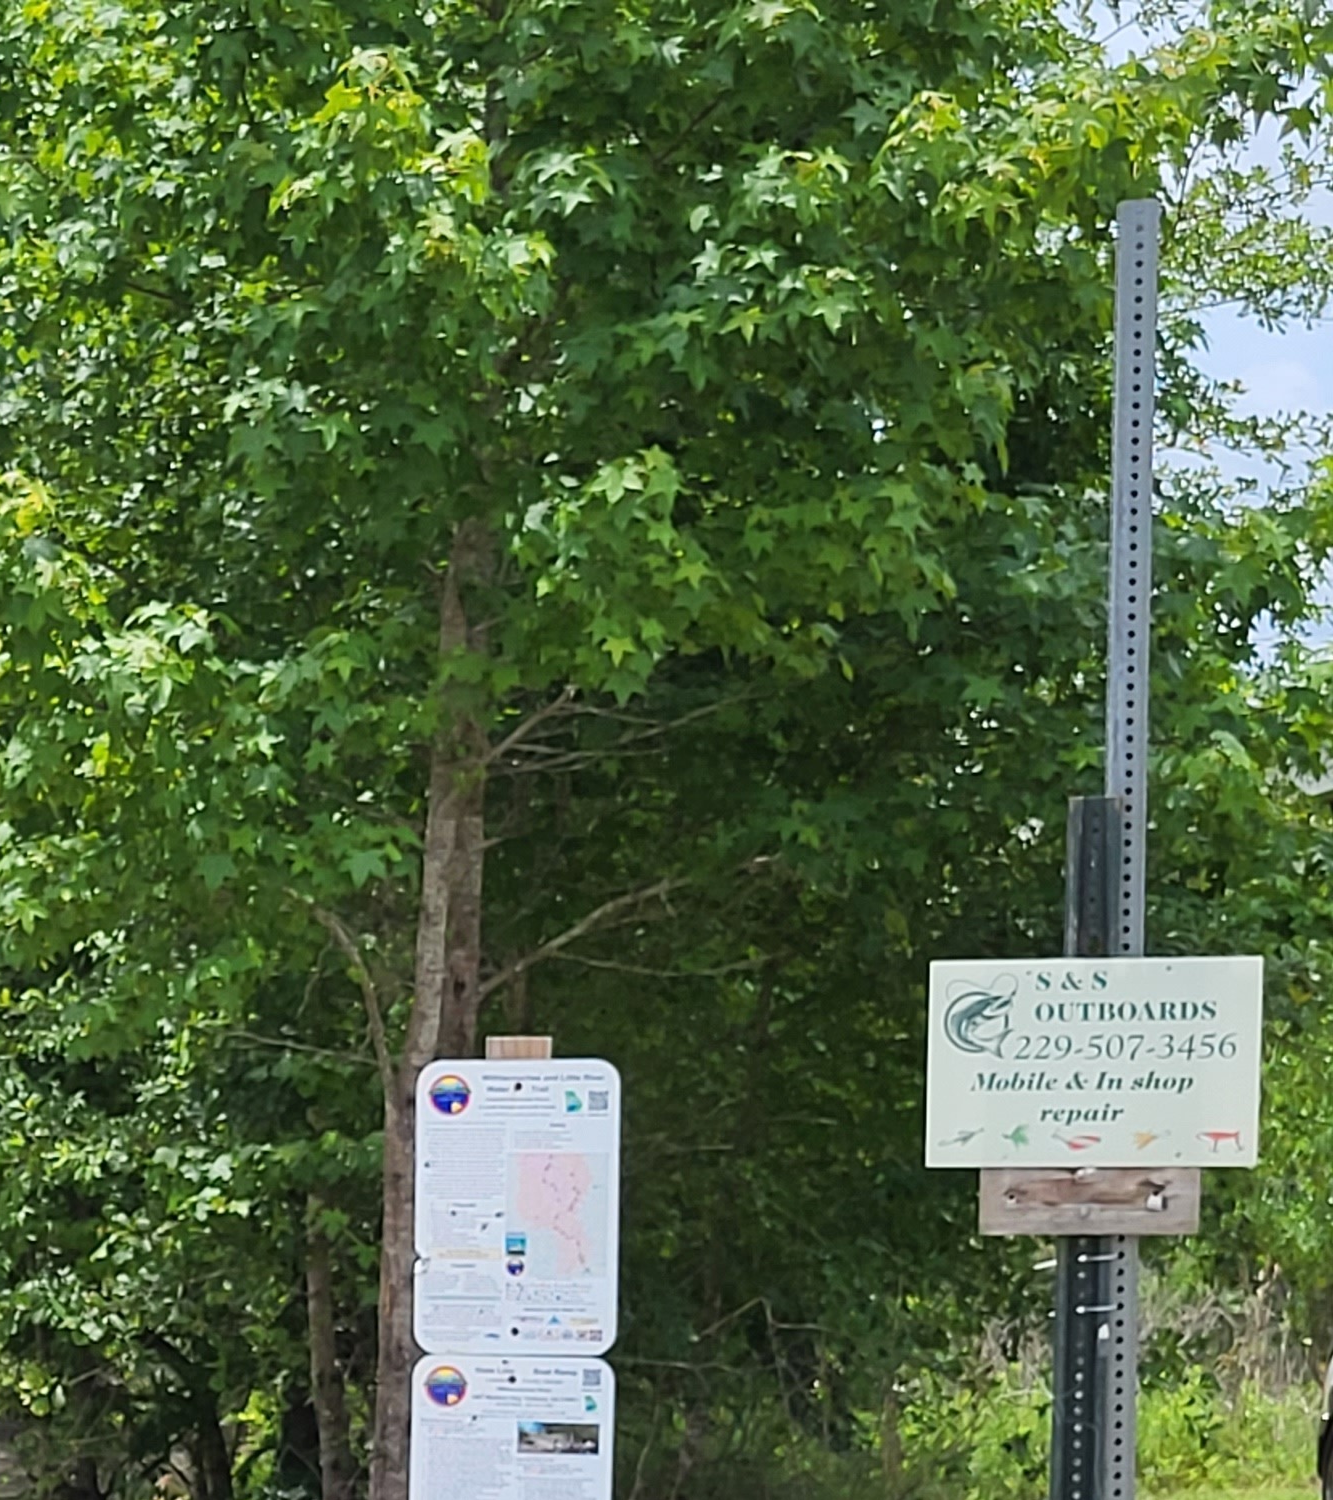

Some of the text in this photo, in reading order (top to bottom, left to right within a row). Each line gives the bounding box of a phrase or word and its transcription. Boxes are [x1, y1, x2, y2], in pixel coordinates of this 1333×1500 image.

[1035, 970, 1109, 991] S & S
[1035, 1000, 1217, 1022] OUTBOARDS
[1013, 1033, 1238, 1061] 229-507-3456
[970, 1070, 1194, 1094] Mobile & In shop
[1039, 1103, 1125, 1126] repair
